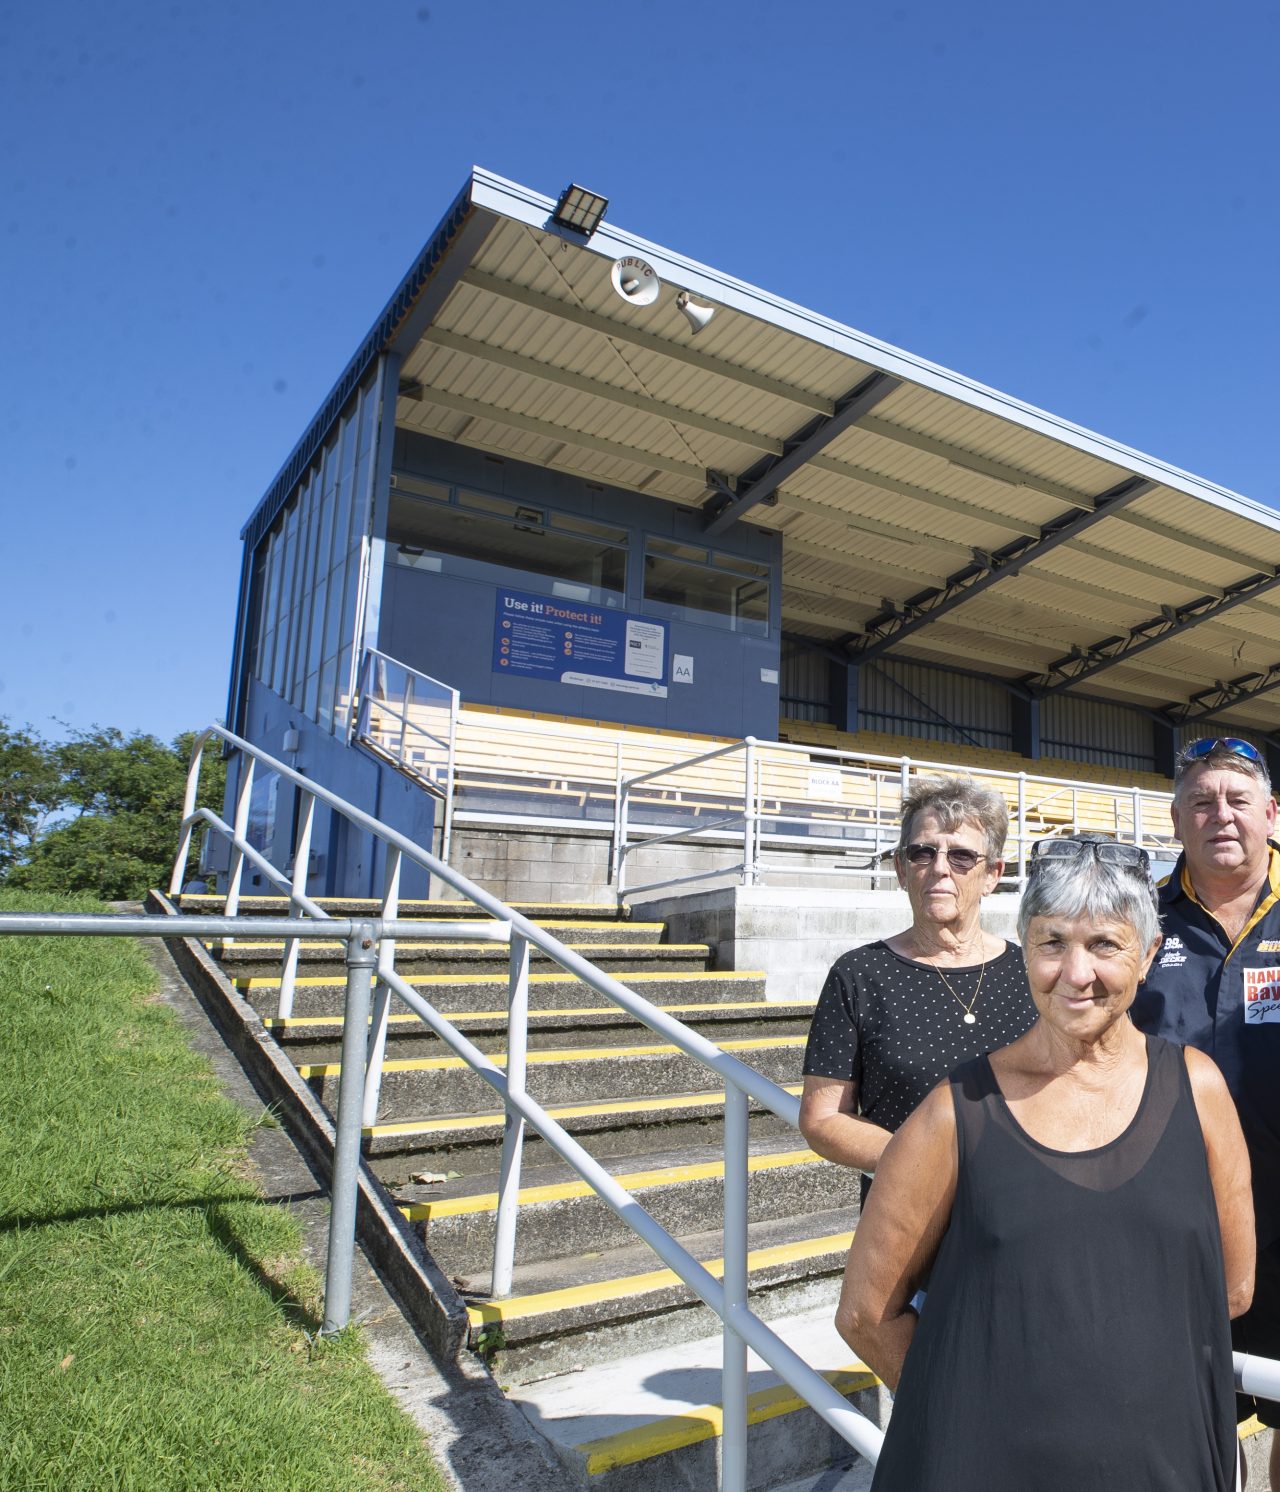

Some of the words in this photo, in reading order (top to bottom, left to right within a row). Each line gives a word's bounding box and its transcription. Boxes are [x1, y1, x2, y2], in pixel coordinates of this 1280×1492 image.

[504, 597, 529, 610] Use
[530, 602, 544, 614] it!
[545, 605, 588, 622] Protect
[590, 613, 602, 625] it!
[676, 666, 691, 677] AA
